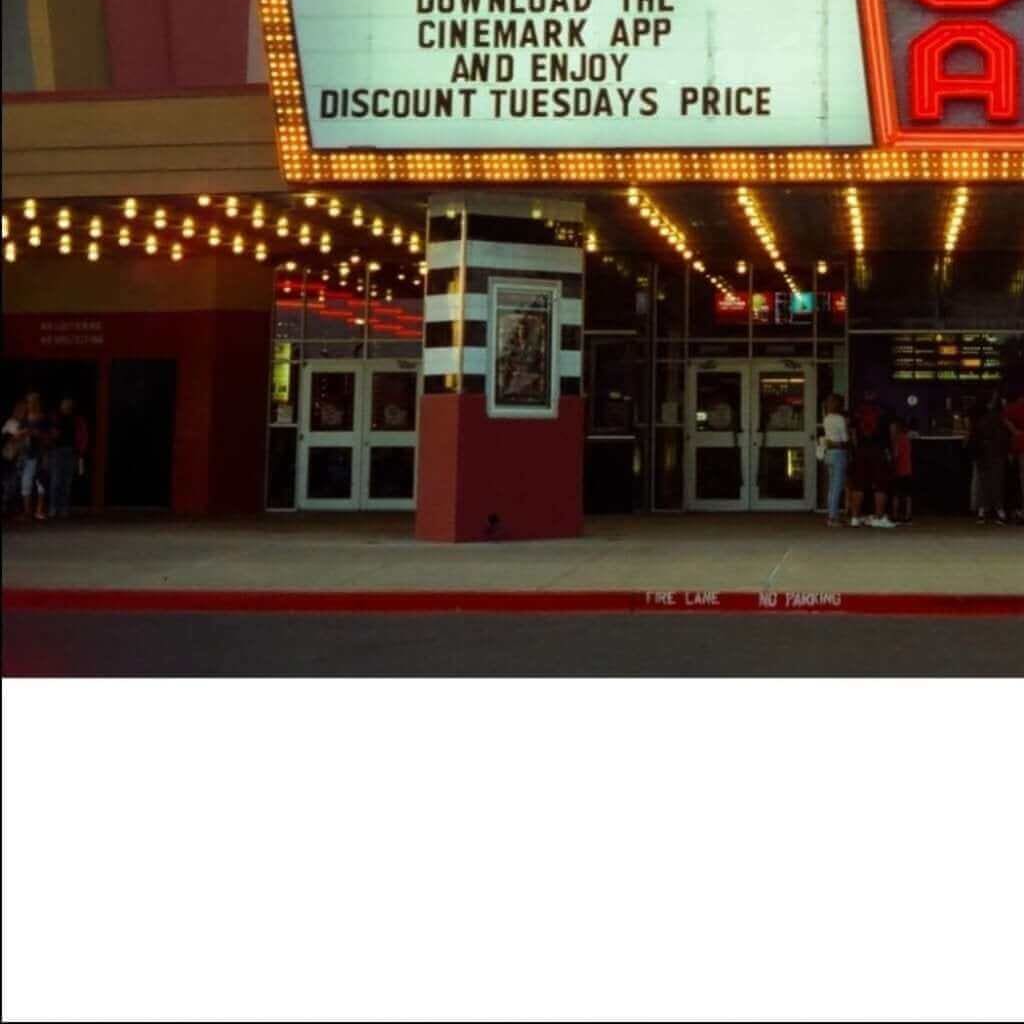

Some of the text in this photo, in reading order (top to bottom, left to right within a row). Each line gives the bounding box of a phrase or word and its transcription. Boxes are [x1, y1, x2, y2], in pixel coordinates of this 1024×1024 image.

[418, 18, 671, 49] CINEMARK APP
[450, 53, 628, 83] AND ENJOY
[319, 86, 770, 120] DISCOUNT TUESDAYS PRICE
[645, 591, 842, 608] FIRE LANE NO PARKING
